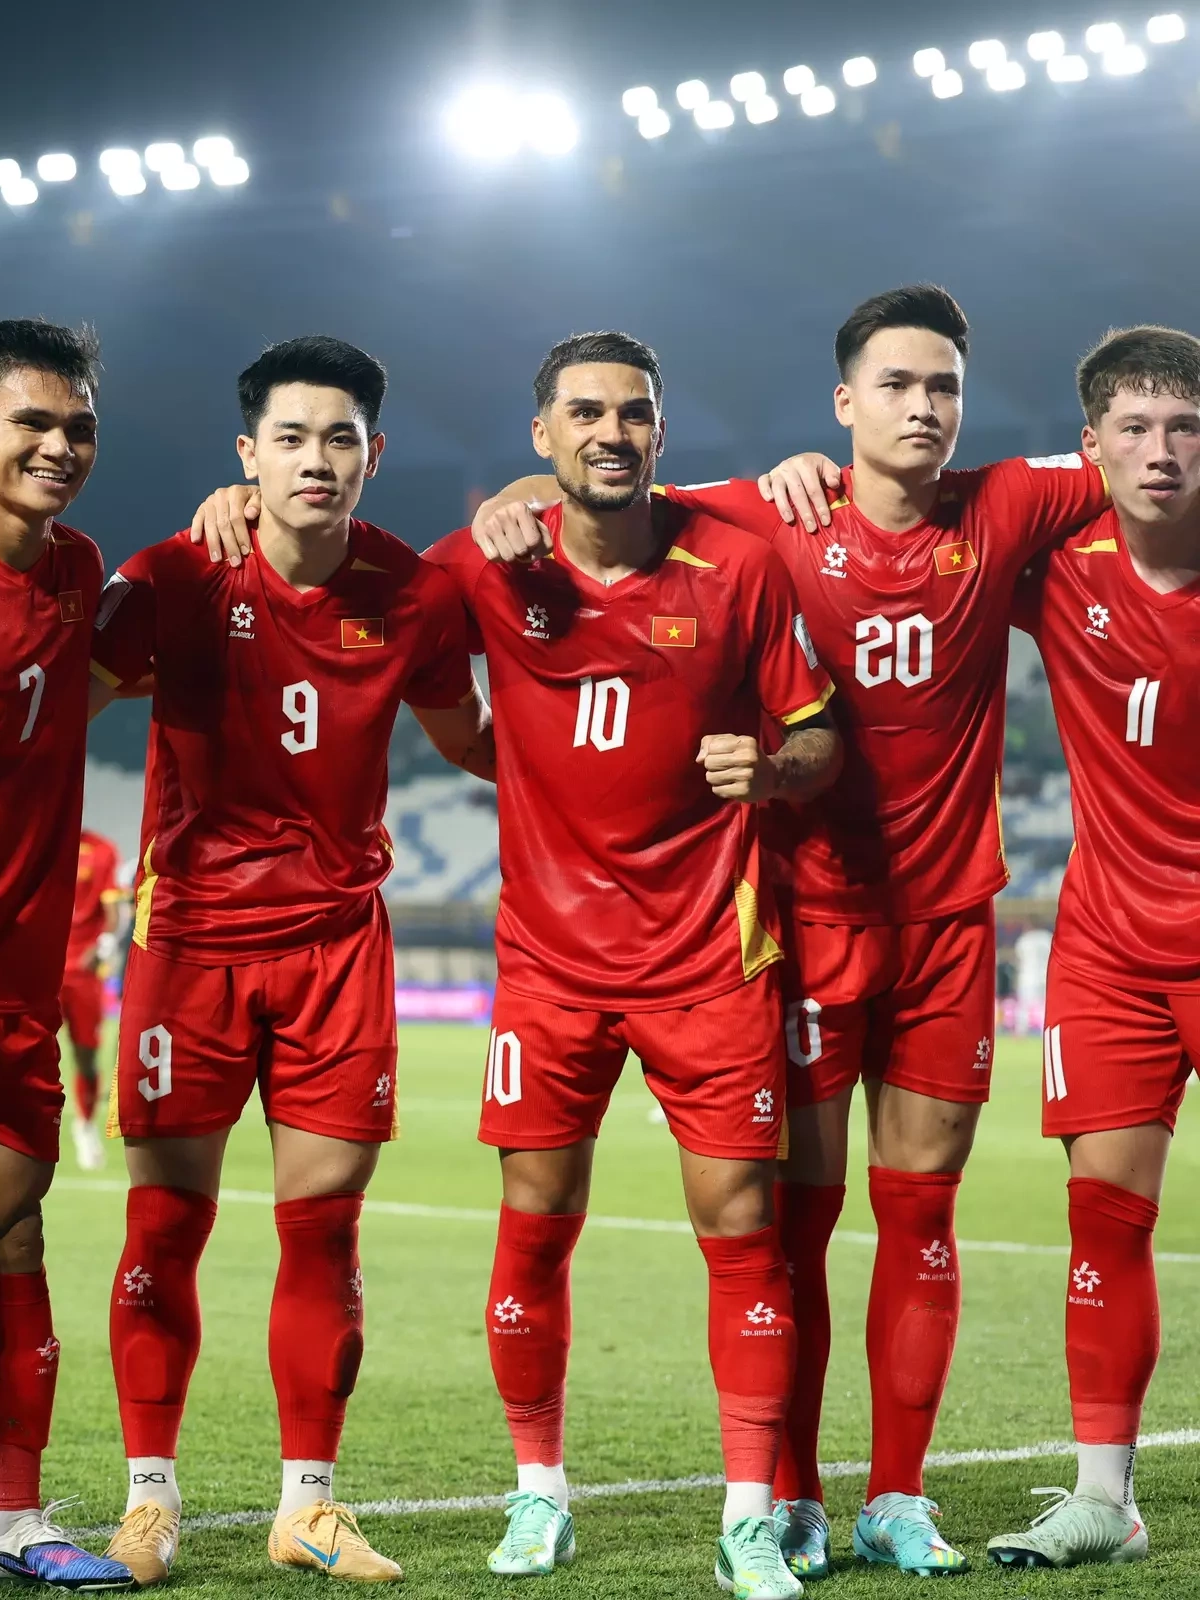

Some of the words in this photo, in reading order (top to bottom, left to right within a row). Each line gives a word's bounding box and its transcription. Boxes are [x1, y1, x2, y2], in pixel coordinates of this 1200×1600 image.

[854, 612, 934, 690] 20
[18, 662, 45, 743] 7
[280, 679, 319, 757] 9
[572, 675, 631, 753] 10
[1125, 676, 1161, 747] 11
[138, 1023, 173, 1102] 9
[485, 1025, 522, 1108] 10
[1044, 1023, 1068, 1103] 11
